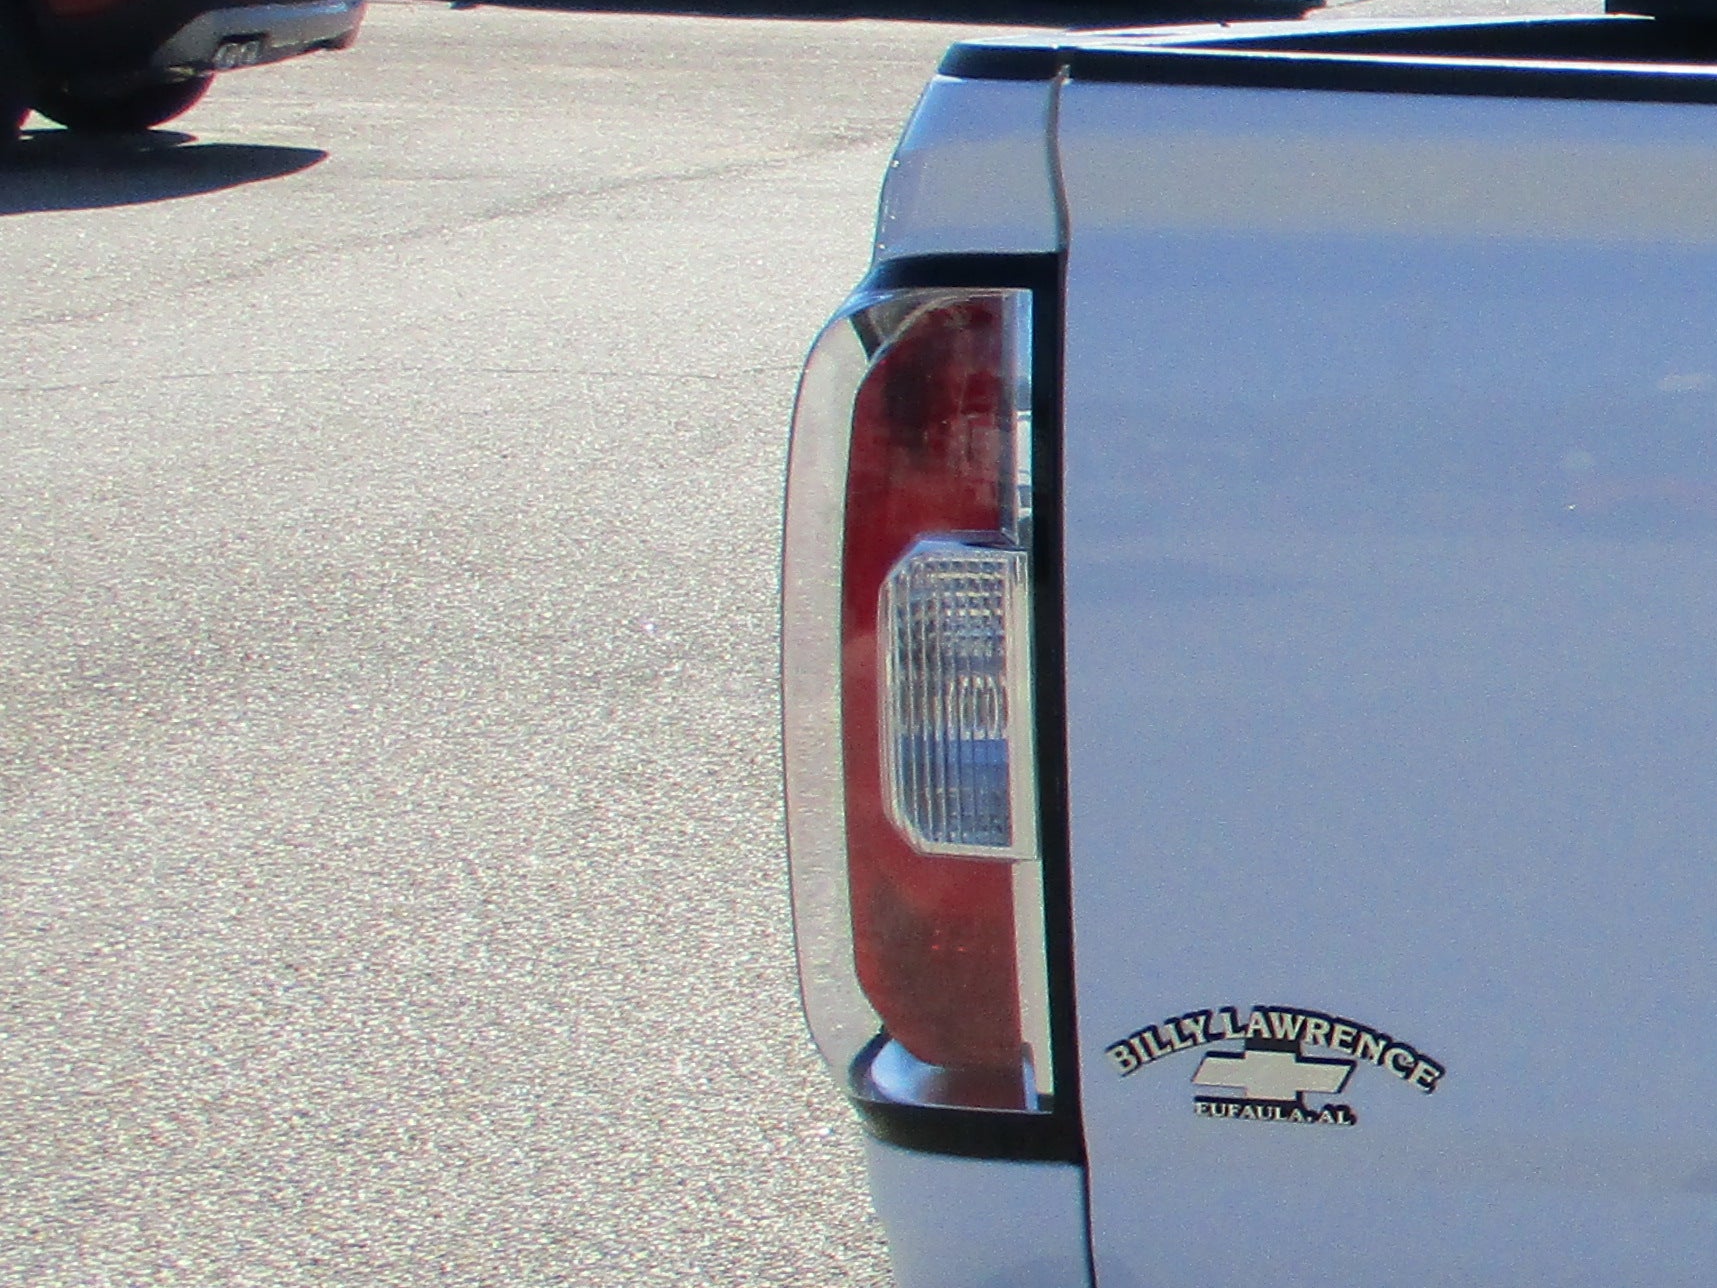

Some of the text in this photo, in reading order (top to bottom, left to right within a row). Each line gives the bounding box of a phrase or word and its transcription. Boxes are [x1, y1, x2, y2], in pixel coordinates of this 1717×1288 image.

[1105, 1005, 1446, 1094] BILLY LAWRENCE
[1318, 1107, 1354, 1126] AL
